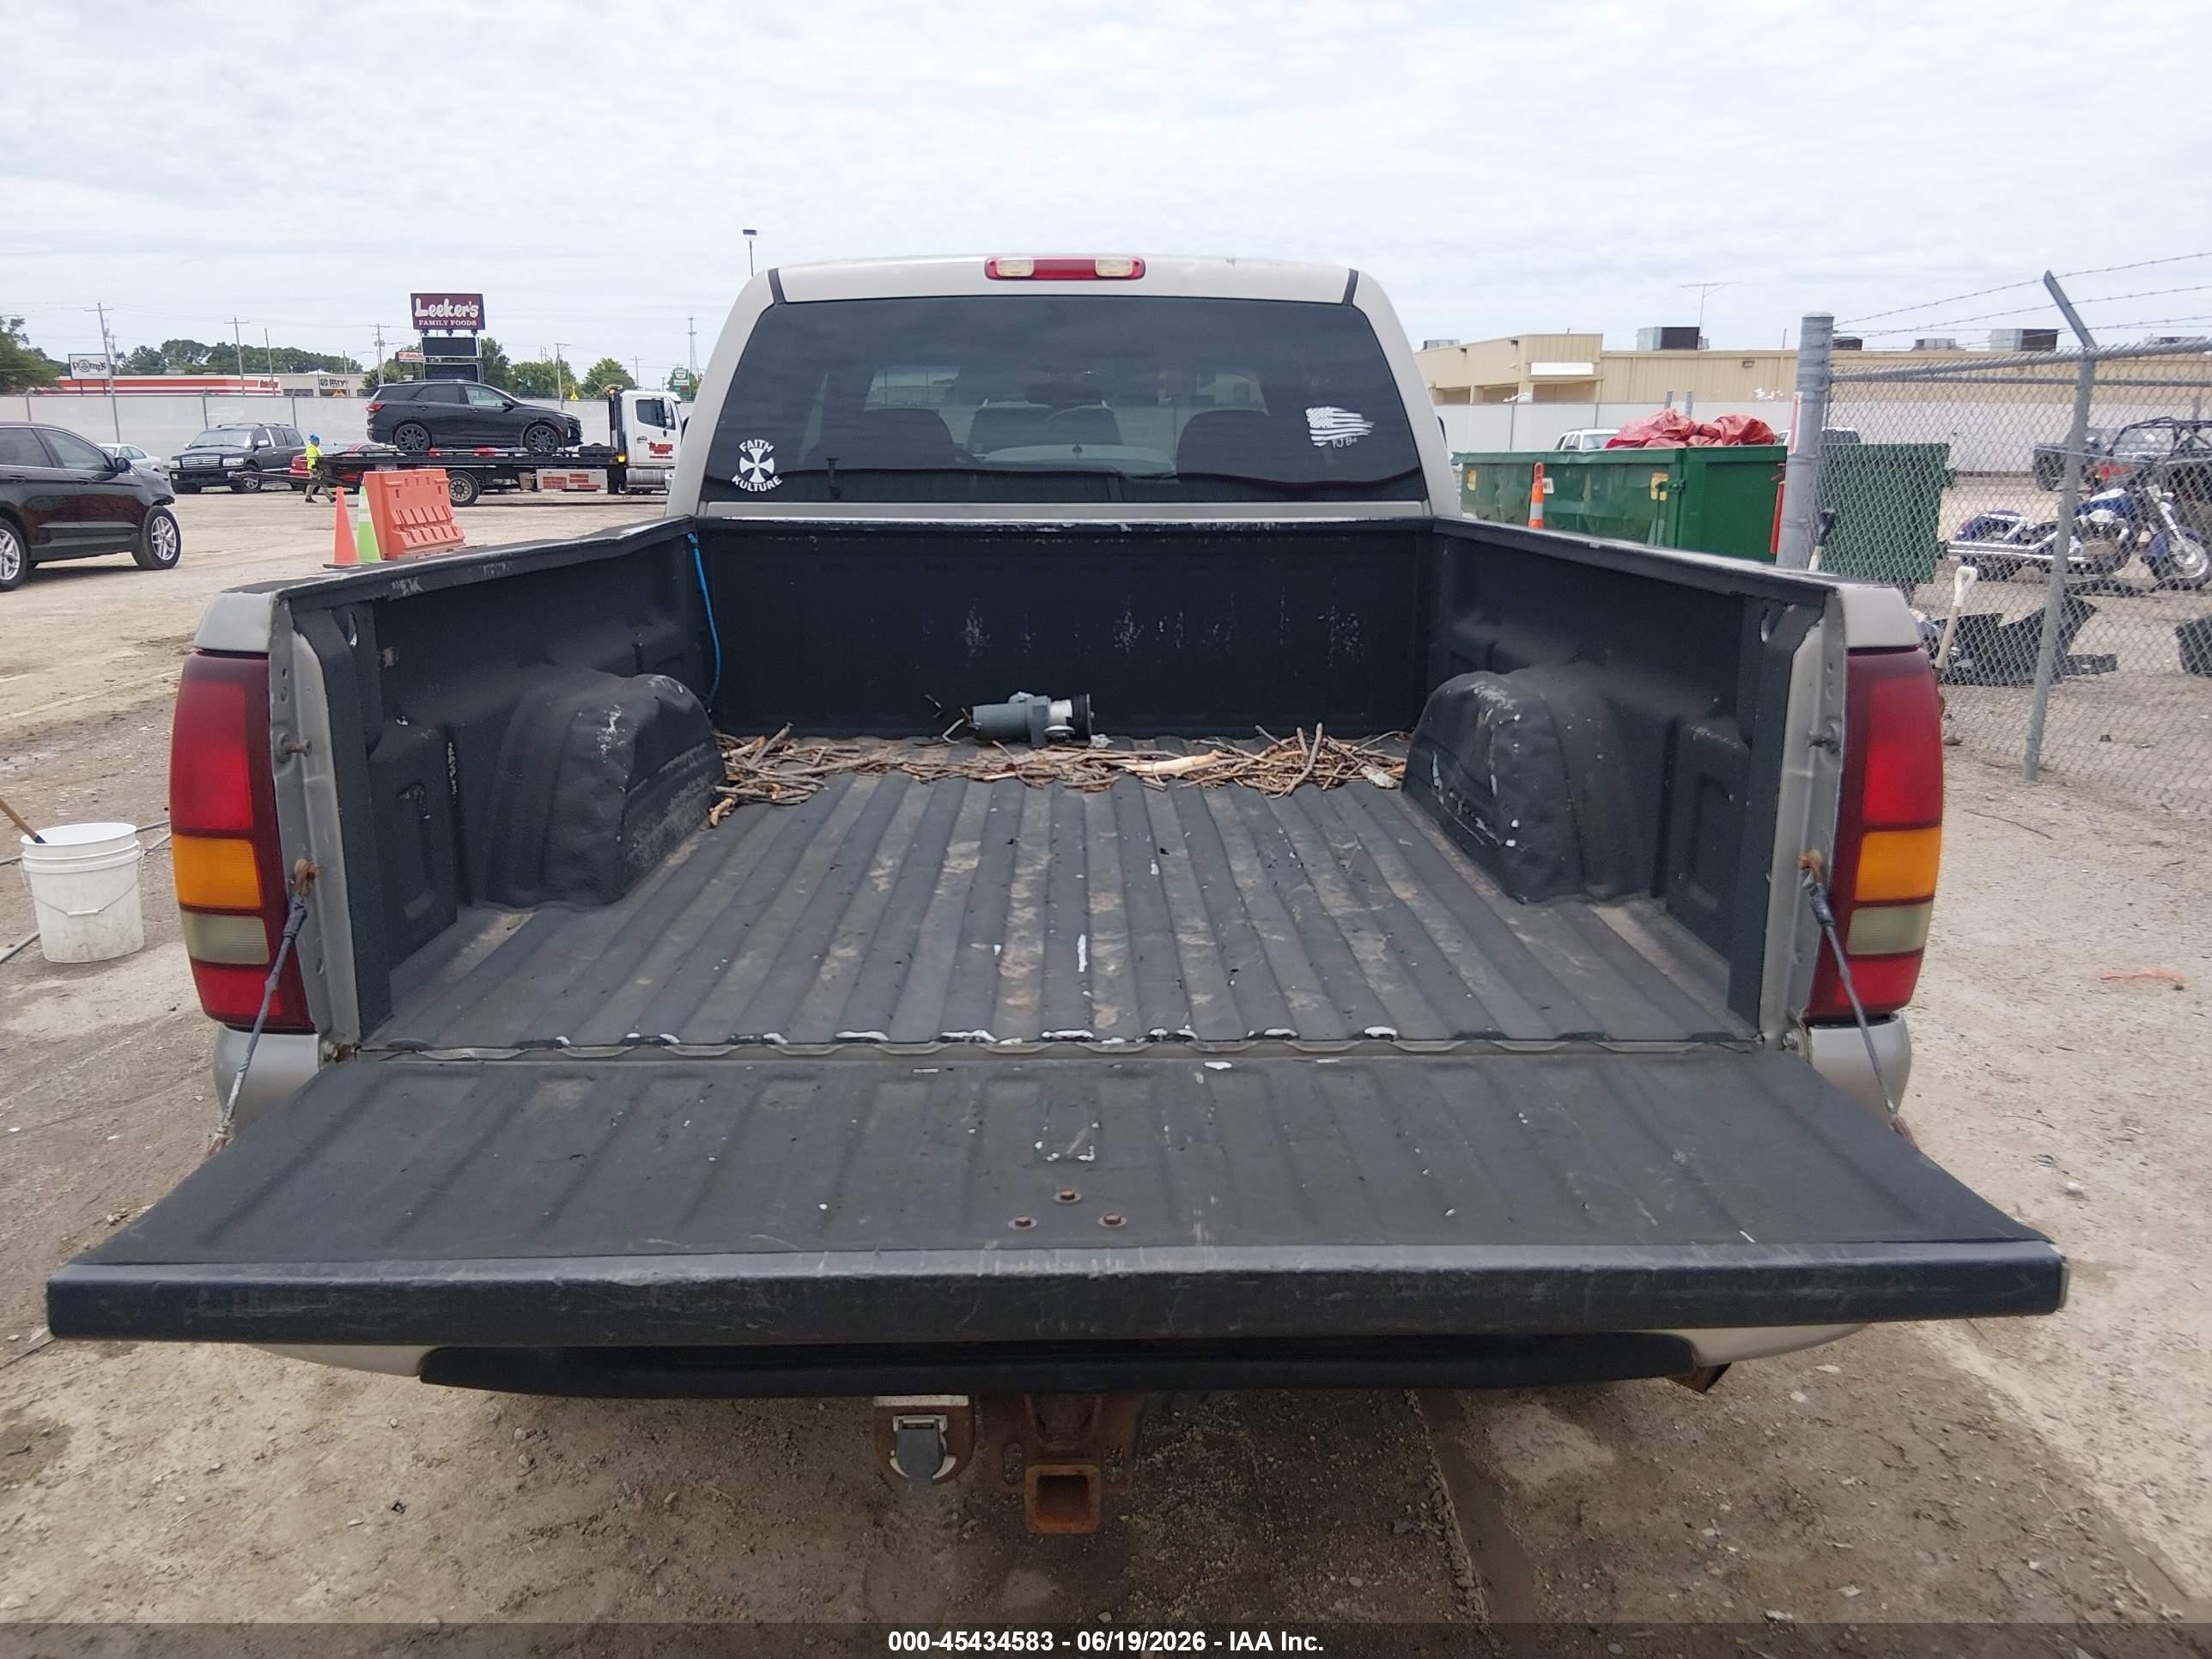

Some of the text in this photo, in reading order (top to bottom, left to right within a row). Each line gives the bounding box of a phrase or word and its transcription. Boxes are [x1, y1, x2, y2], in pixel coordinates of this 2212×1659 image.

[415, 298, 479, 318] Leeker's
[738, 439, 775, 453] FAITH
[732, 475, 783, 492] KULTURE
